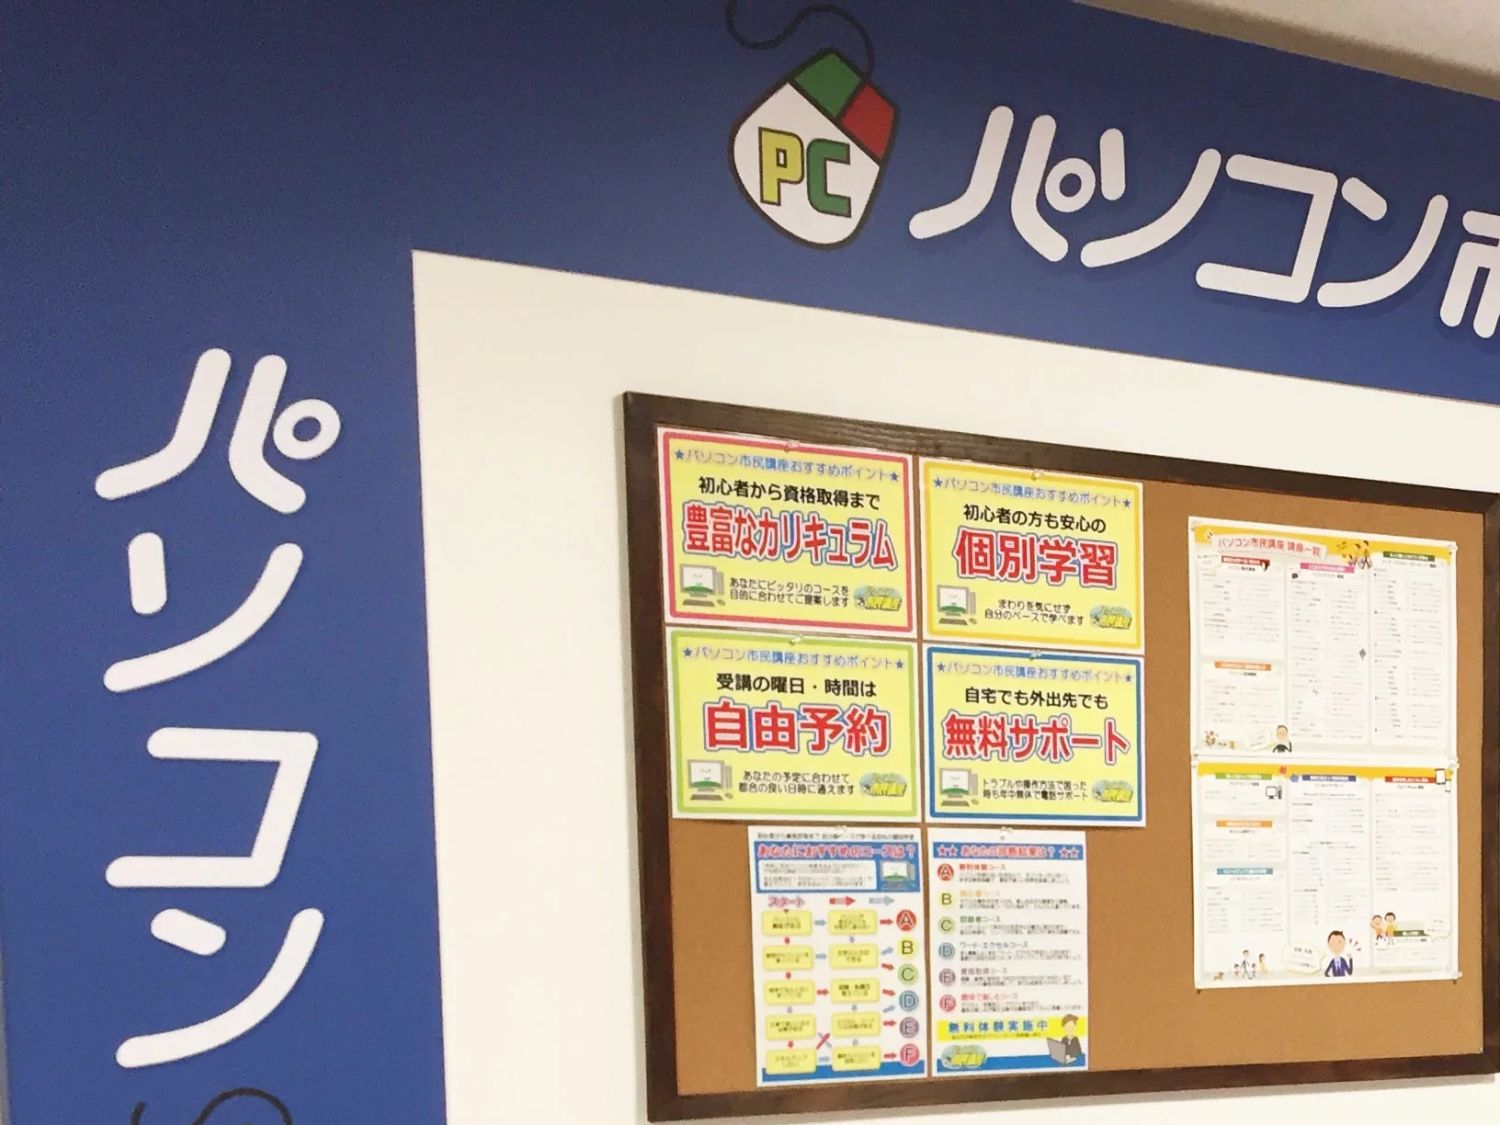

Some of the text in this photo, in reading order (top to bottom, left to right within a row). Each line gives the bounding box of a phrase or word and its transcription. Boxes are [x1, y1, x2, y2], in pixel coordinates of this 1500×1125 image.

[758, 124, 853, 218] PC
[698, 476, 880, 510] 初心者から資格取得まで
[683, 501, 898, 571] 豊富なカリキュラム
[963, 503, 1106, 533] 初心者の方も安心の
[953, 526, 1117, 589] 個別学習
[716, 673, 877, 697] 受講の曜日・時間は
[965, 687, 1108, 709] 自宅でも外出先でも
[94, 348, 342, 1068] パソコン
[704, 698, 890, 755] 自由予約
[943, 709, 1130, 765] 無料サポート
[901, 940, 914, 955] B
[901, 967, 914, 982] C
